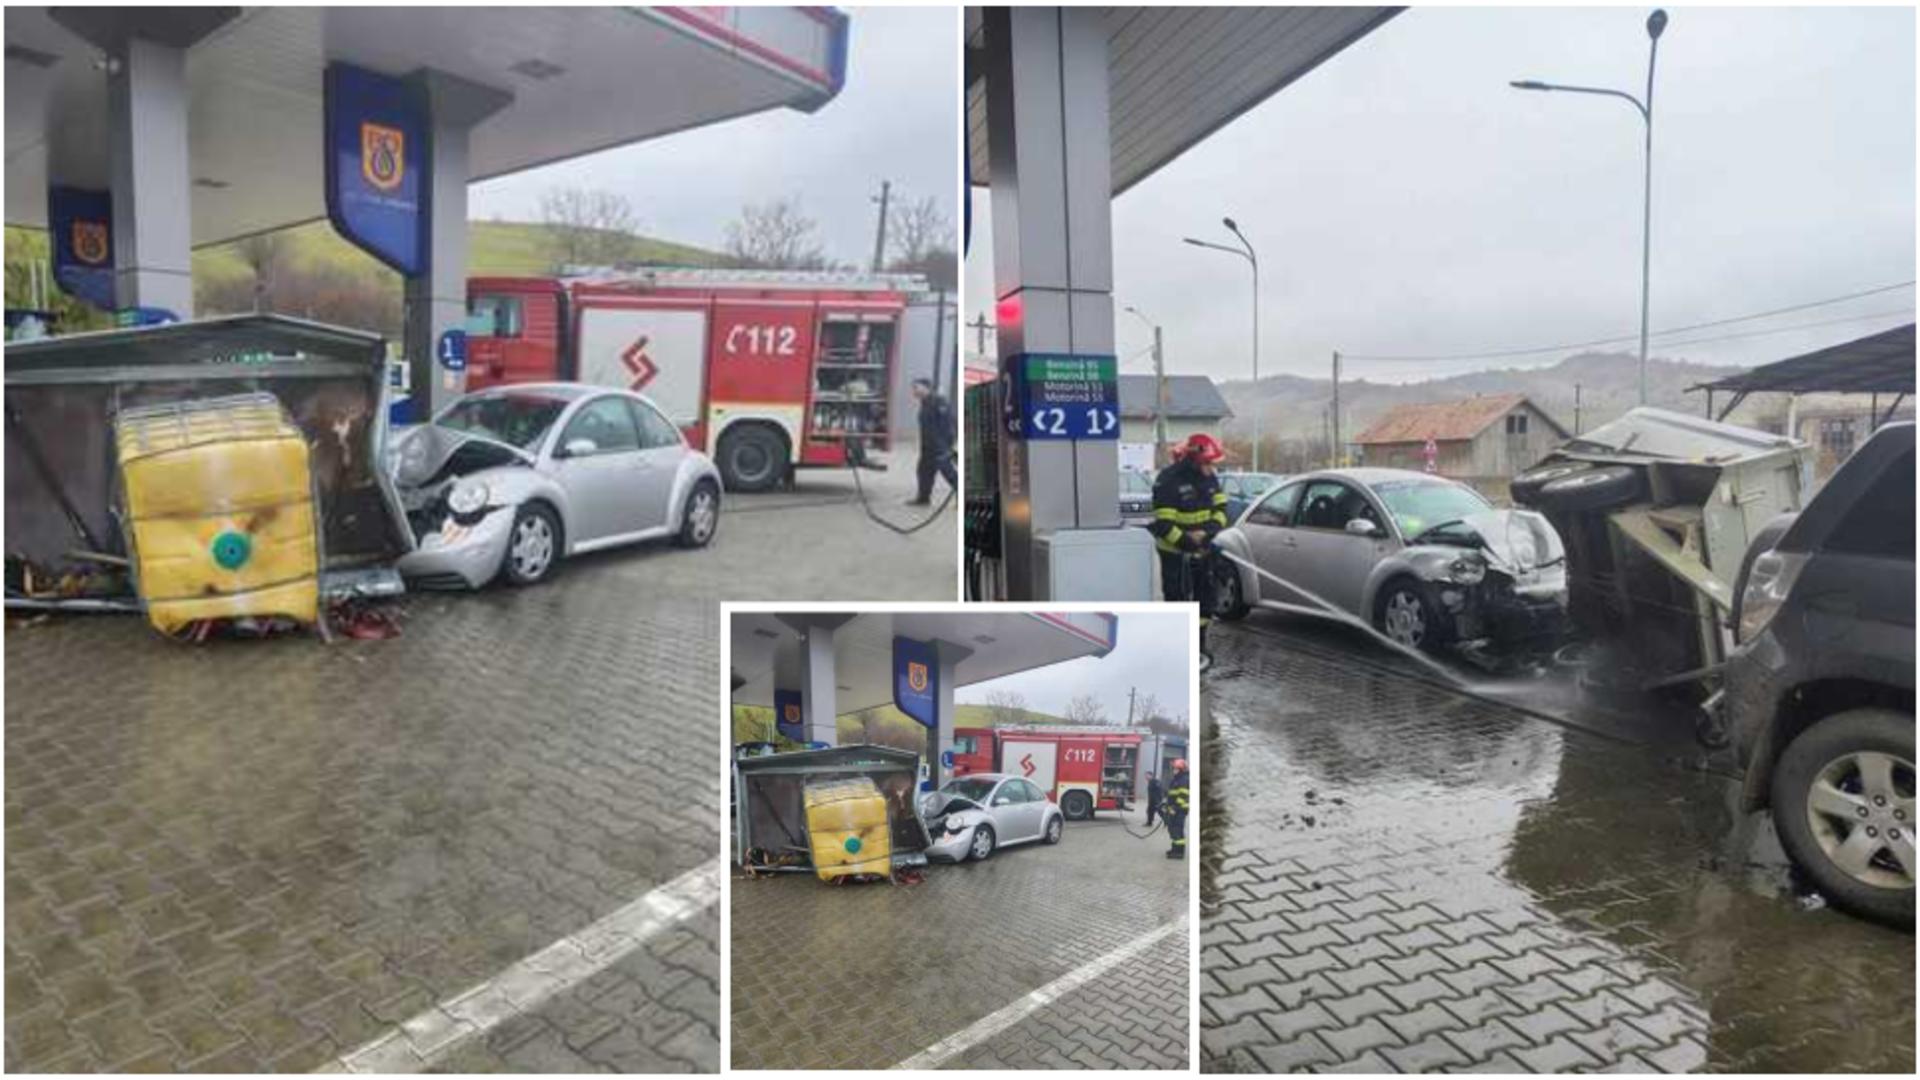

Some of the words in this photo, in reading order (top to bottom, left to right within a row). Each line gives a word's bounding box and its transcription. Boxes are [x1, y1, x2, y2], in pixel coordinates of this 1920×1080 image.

[748, 325, 796, 355] 112
[1050, 408, 1067, 434] 2
[1086, 408, 1102, 434] 1
[1074, 749, 1096, 763] 112
